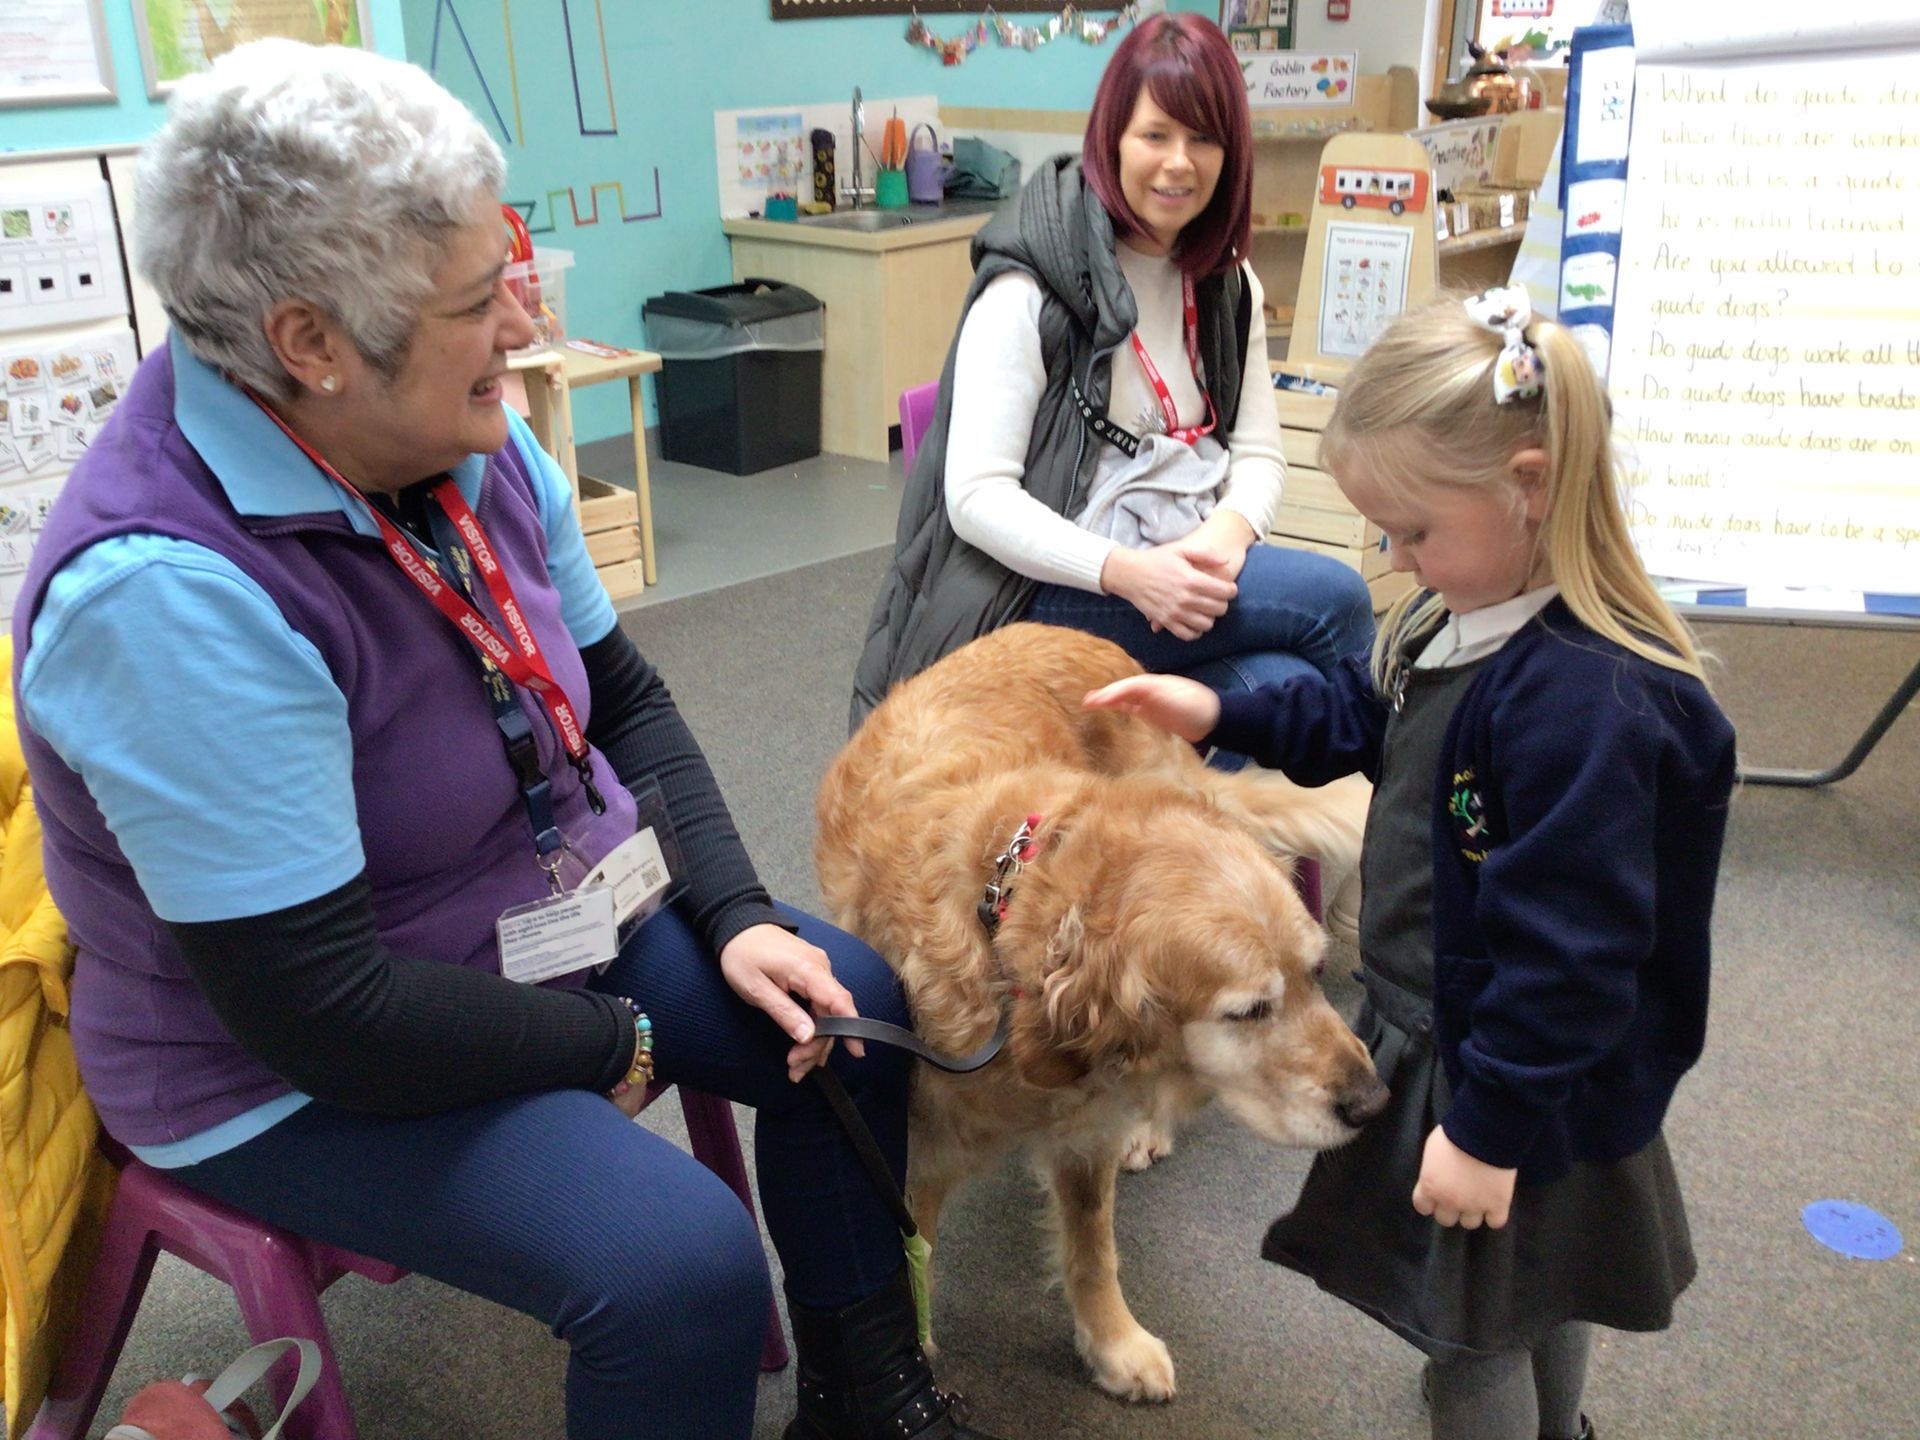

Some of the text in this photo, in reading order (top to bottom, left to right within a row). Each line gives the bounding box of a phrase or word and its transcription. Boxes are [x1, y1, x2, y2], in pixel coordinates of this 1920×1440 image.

[1263, 81, 1312, 101] Factory
[1270, 59, 1306, 77] Goblin
[1661, 72, 1726, 104] What
[1660, 200, 1682, 231] he
[1652, 240, 1904, 286] Are you allowed to
[1650, 291, 1706, 325] guide
[1648, 329, 1676, 358] Do
[1685, 338, 1734, 373] guide
[1741, 339, 1790, 377] dogs
[1804, 341, 1851, 364] work
[1861, 342, 1894, 366] all
[1641, 373, 1916, 420] Do guide dogs have treats
[1093, 418, 1138, 453] AINTS
[1636, 416, 1674, 442] How
[1683, 432, 1731, 447] many
[1799, 429, 1842, 464] dogs
[1848, 434, 1878, 453] are
[1888, 436, 1913, 455] on
[1630, 498, 1658, 529] Do
[1773, 507, 1813, 537] have
[1844, 515, 1865, 539] be
[1872, 524, 1884, 543] a
[457, 512, 498, 576] VISITOR
[390, 540, 444, 598] VISITOR
[460, 612, 511, 665] VISITOR
[502, 597, 537, 659] VISITOR
